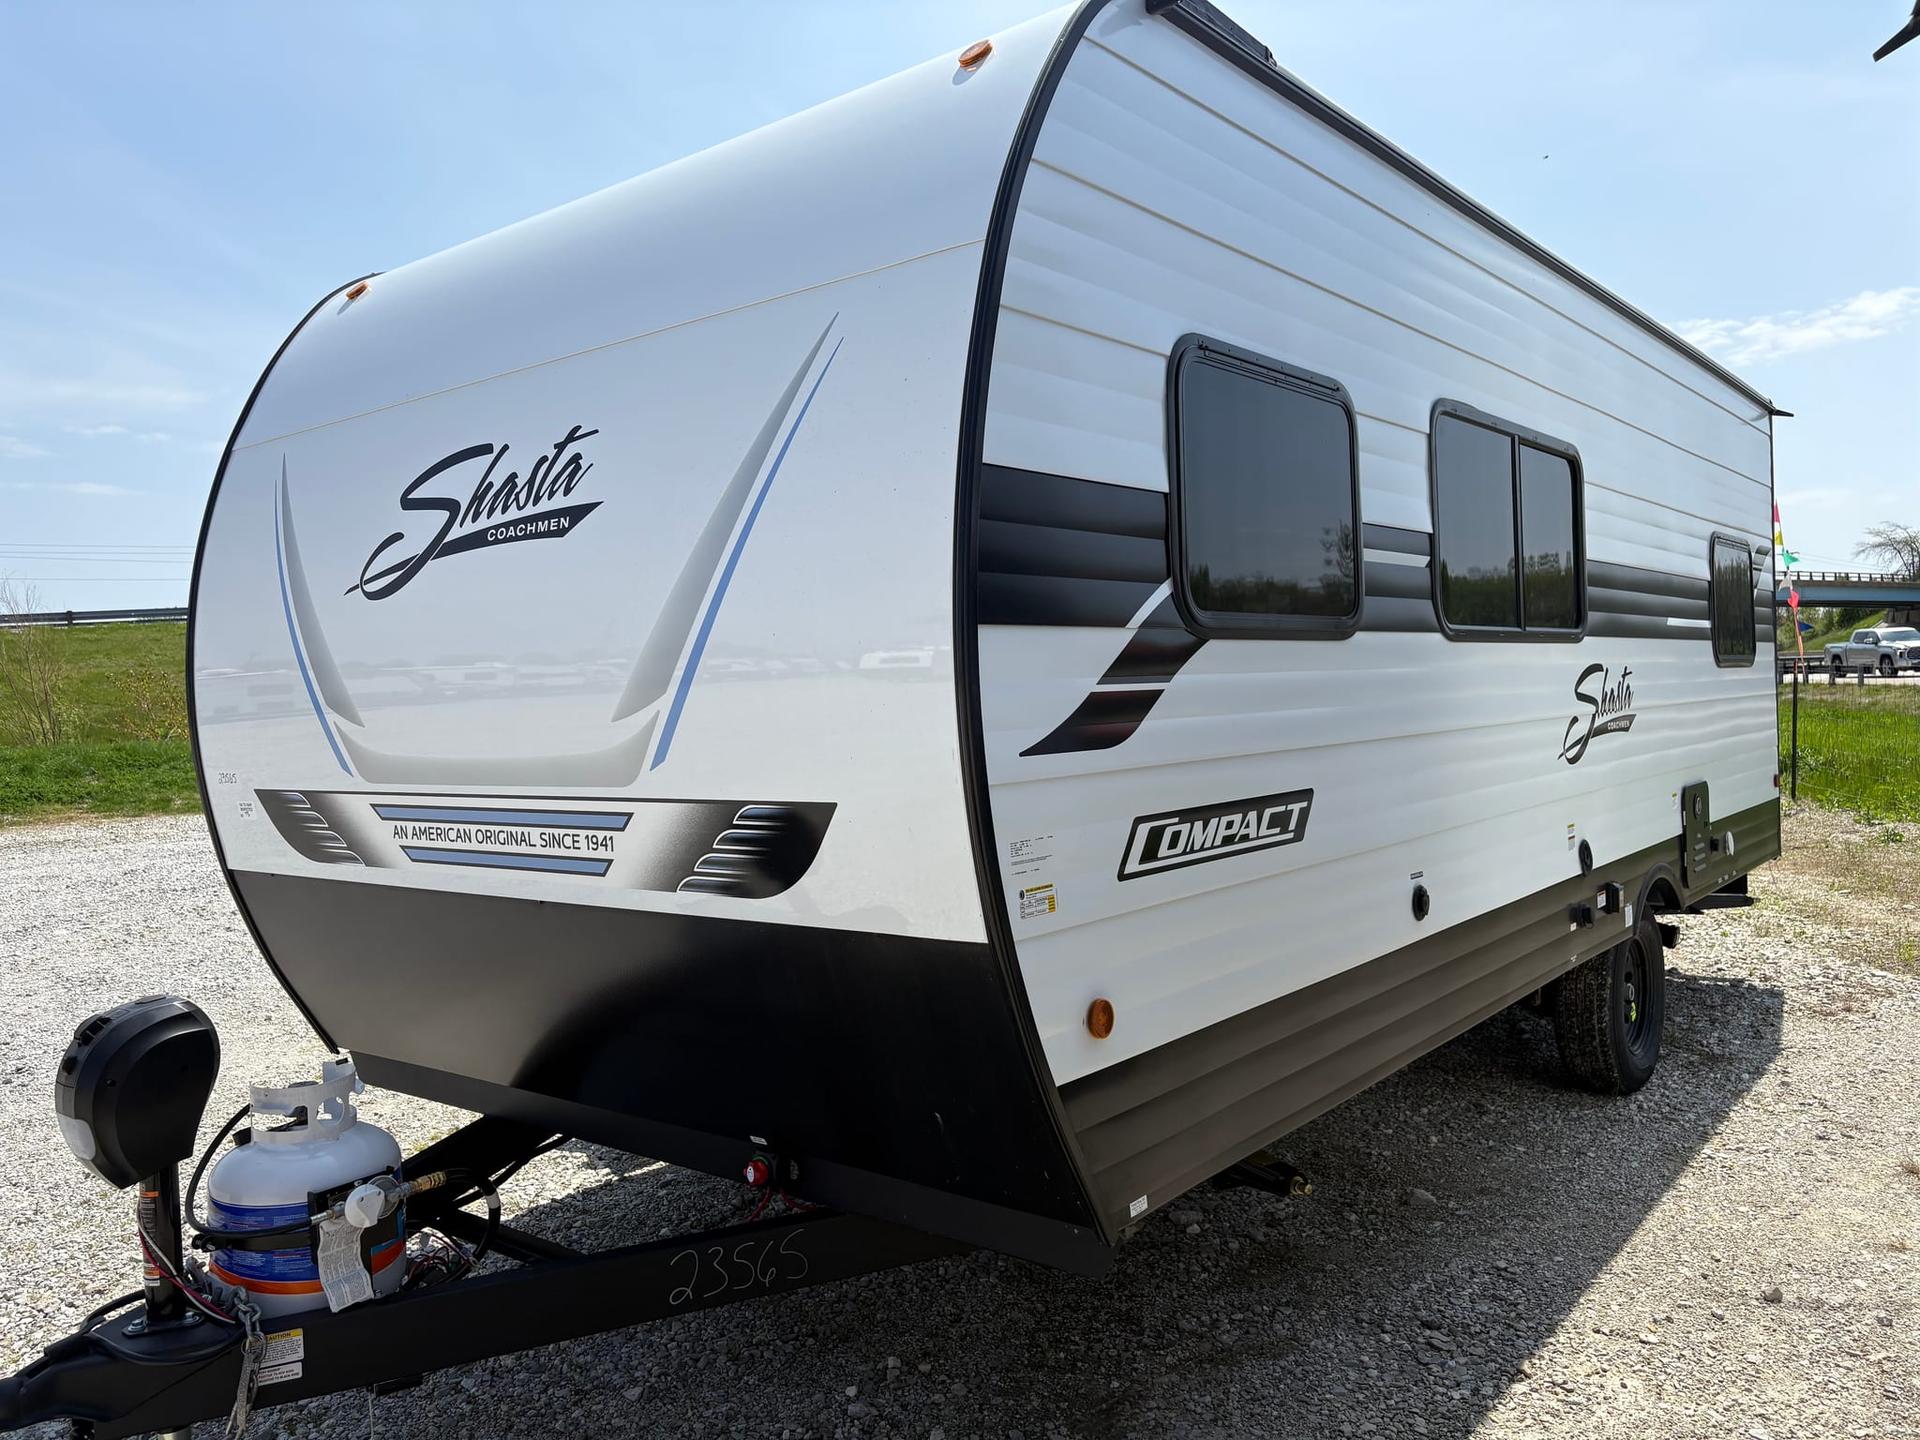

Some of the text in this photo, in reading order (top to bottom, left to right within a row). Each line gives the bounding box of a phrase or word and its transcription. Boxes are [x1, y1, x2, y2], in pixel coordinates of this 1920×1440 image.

[360, 425, 599, 600] Shasta
[487, 516, 571, 541] COACHMEN
[1563, 663, 1634, 765] Shasta
[1607, 720, 1630, 730] COACHMEN
[393, 825, 614, 852] AN AMERICAN ORIGINAL SINCE 1941
[1124, 801, 1308, 874] COMPACT
[669, 1228, 808, 1304] 23565
[266, 1332, 292, 1342] AUTION
